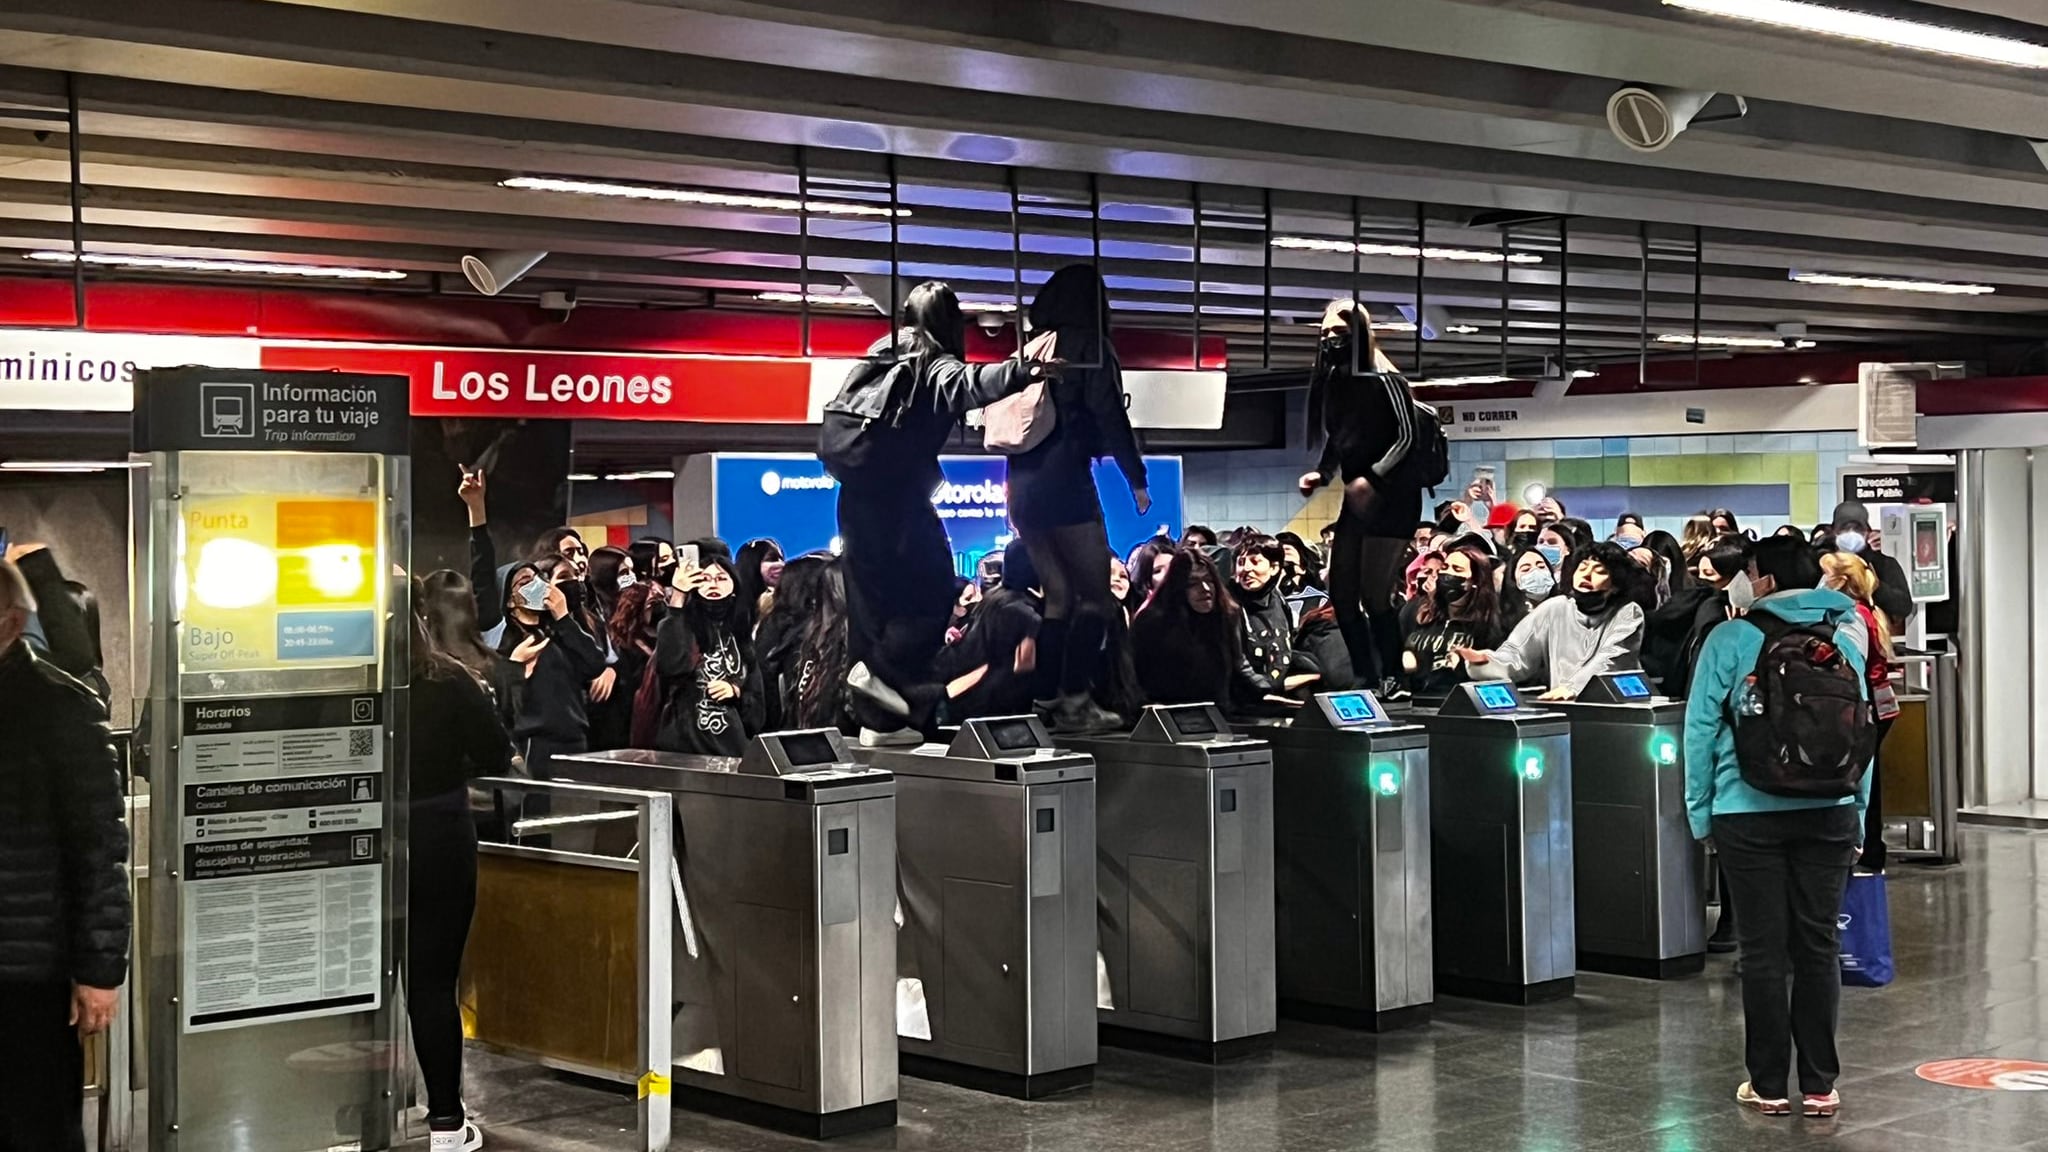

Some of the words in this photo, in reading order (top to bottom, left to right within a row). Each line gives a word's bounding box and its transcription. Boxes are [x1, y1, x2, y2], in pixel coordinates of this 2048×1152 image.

[432, 361, 509, 401] Los
[525, 364, 672, 404] Leones
[263, 382, 377, 403] Información
[263, 408, 309, 427] para
[315, 406, 334, 423] tu
[339, 406, 379, 428] viaje
[264, 429, 288, 442] Trip
[291, 430, 356, 442] information
[1856, 476, 1900, 488] Dirección
[1856, 488, 1876, 498] San
[1876, 488, 1904, 498] Pablo
[190, 511, 248, 529] Punta
[190, 627, 234, 650] Bajo
[196, 705, 251, 719] Horarios
[196, 784, 244, 798] Canales
[247, 782, 263, 794] de
[265, 778, 347, 793] comunicación
[195, 843, 238, 855] Normas
[240, 841, 253, 850] de
[249, 854, 256, 865] y
